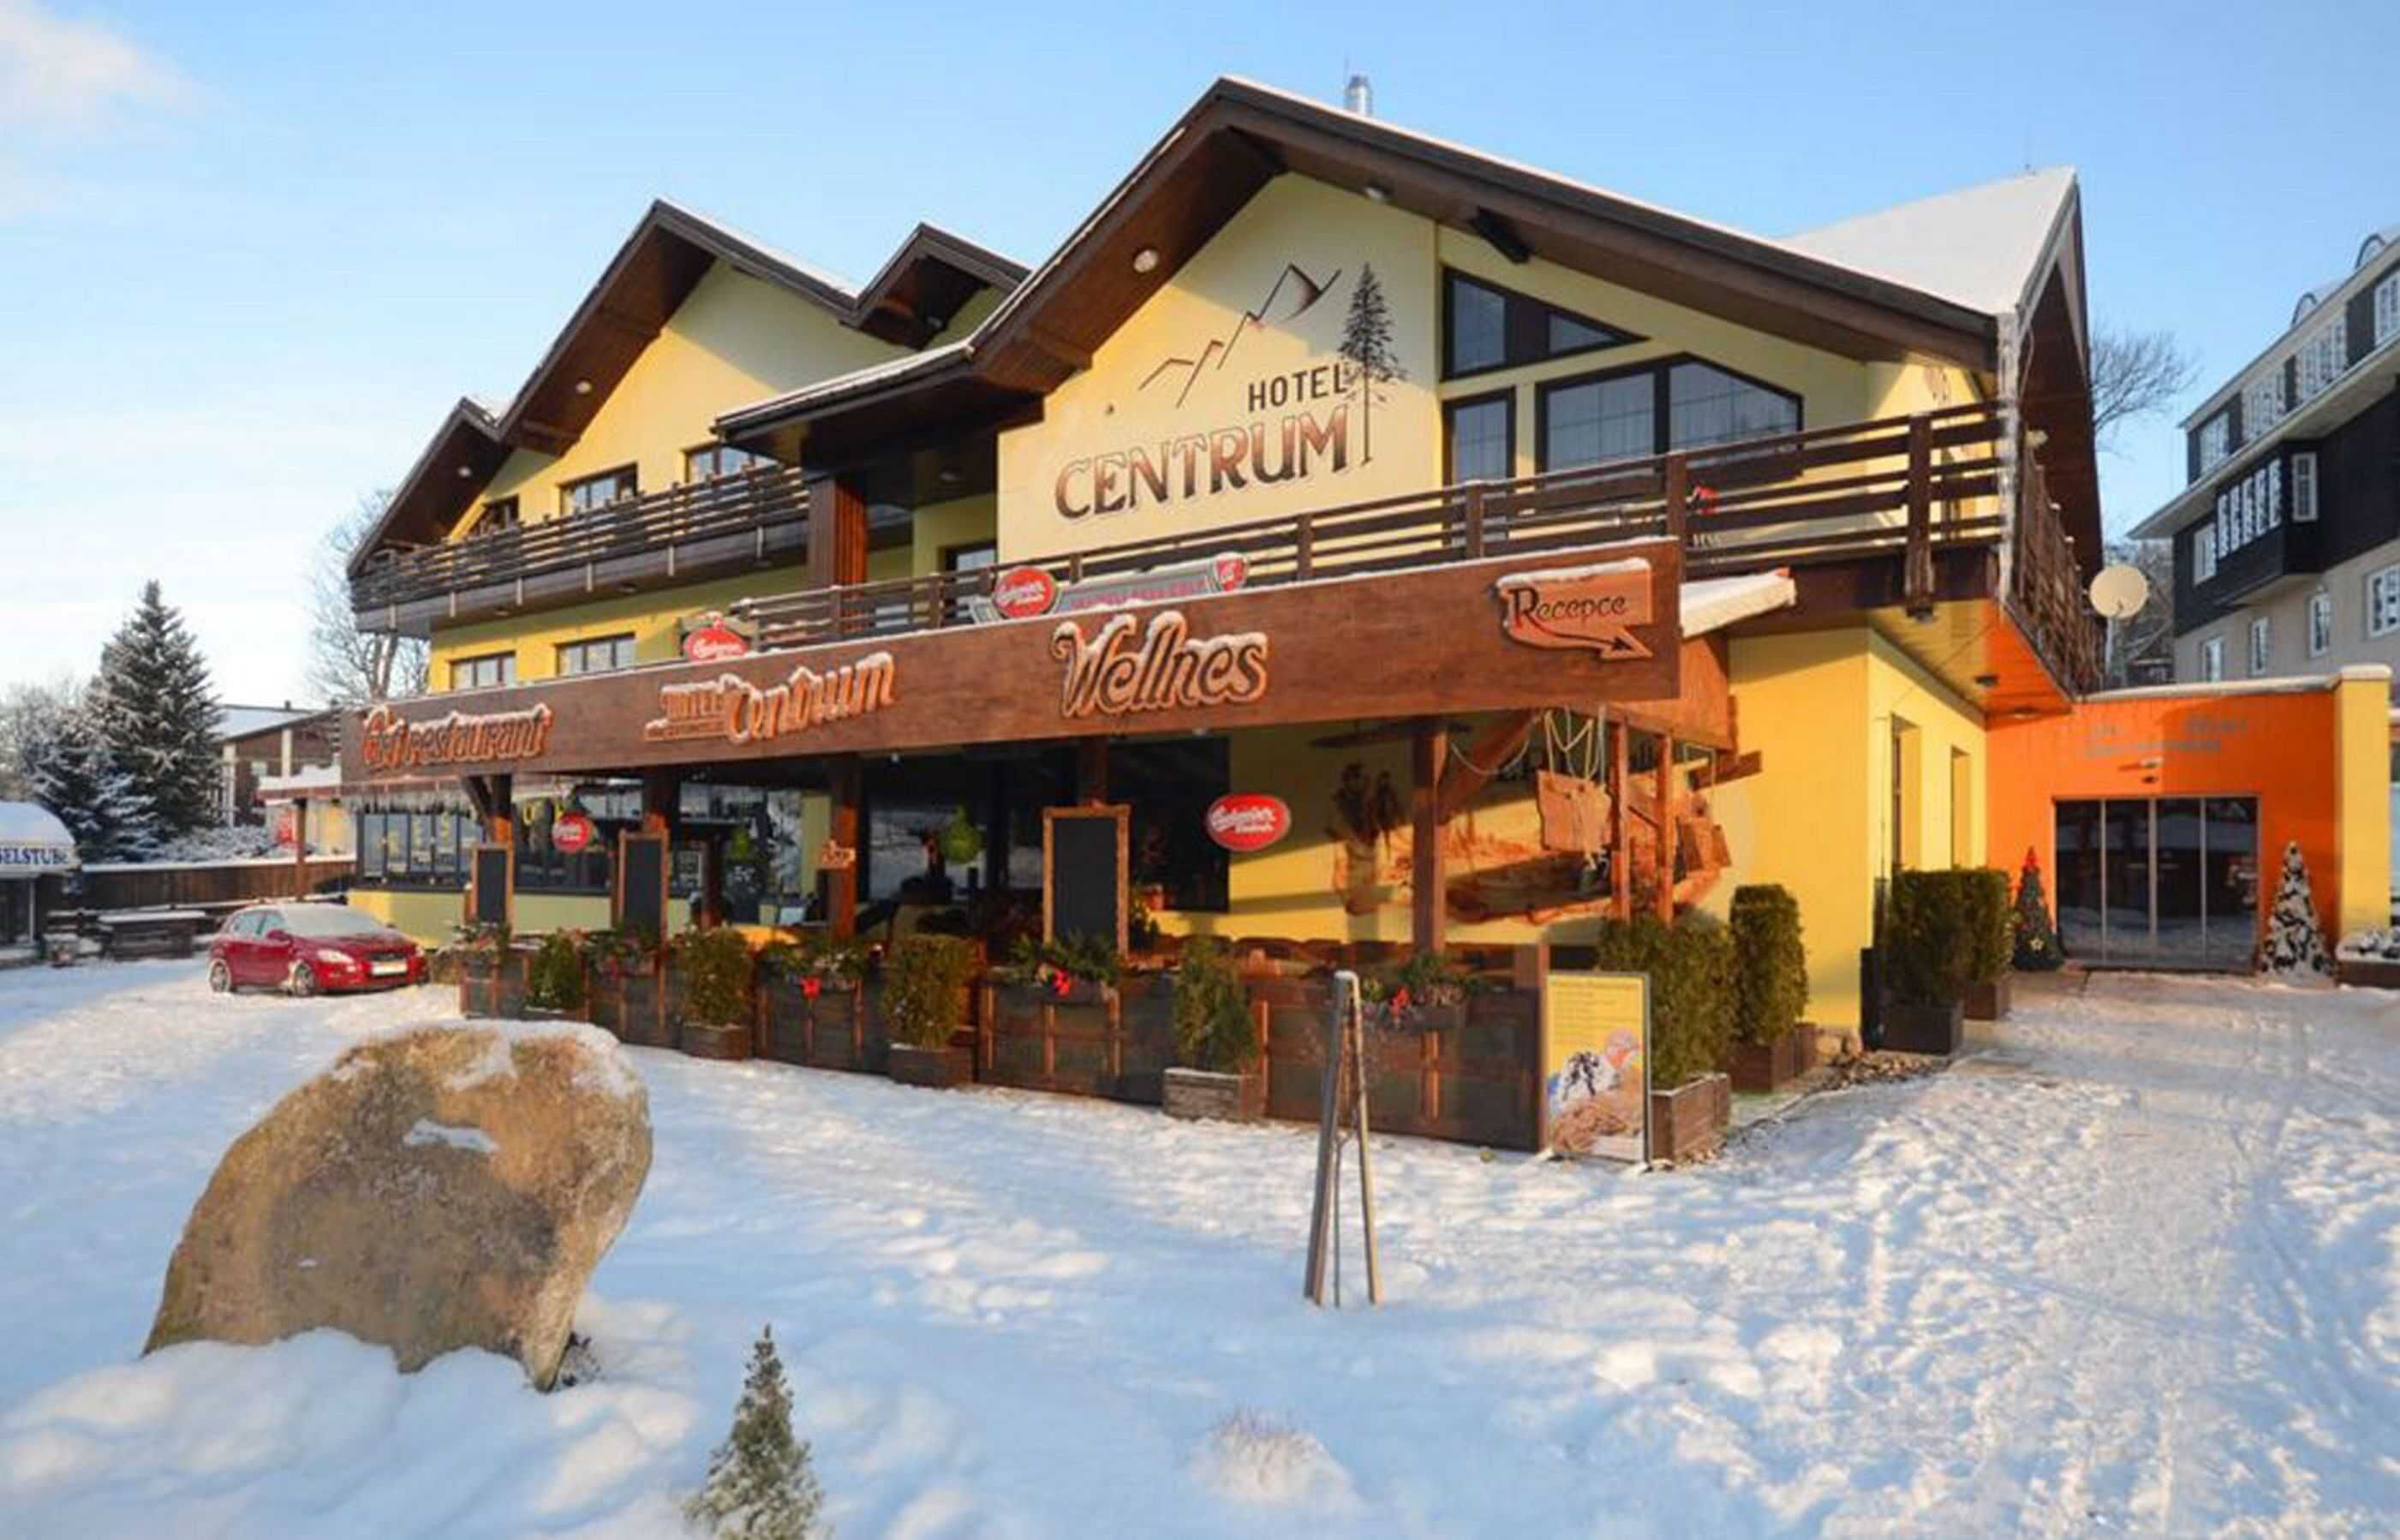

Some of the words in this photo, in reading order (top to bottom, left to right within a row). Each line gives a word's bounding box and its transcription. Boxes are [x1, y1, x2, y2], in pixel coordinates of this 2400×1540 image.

[1247, 361, 1348, 412] HOTEL
[1054, 403, 1349, 520] CENTRUM
[1507, 586, 1627, 629] Recepce
[1051, 606, 1269, 718] Wellnes
